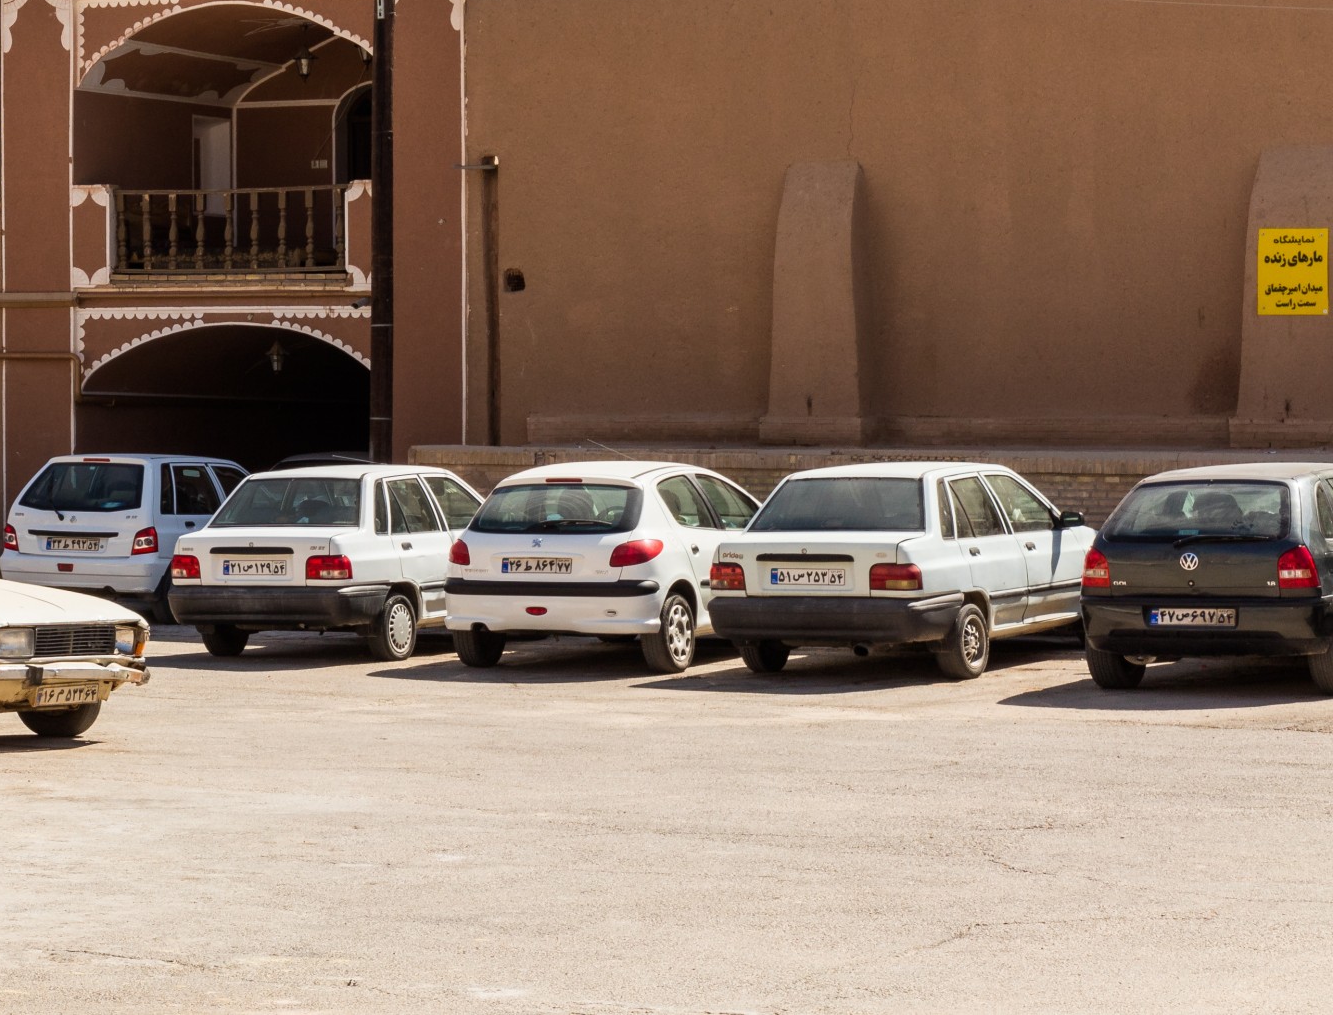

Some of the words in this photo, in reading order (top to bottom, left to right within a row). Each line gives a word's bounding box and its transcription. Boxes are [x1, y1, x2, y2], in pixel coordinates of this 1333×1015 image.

[1273, 235, 1315, 245] نمایشگاه
[1264, 251, 1287, 267] زنده
[1287, 251, 1323, 267] مارهای
[1301, 283, 1323, 294] میدان
[1275, 298, 1296, 310] راست
[1297, 299, 1316, 307] سمت
